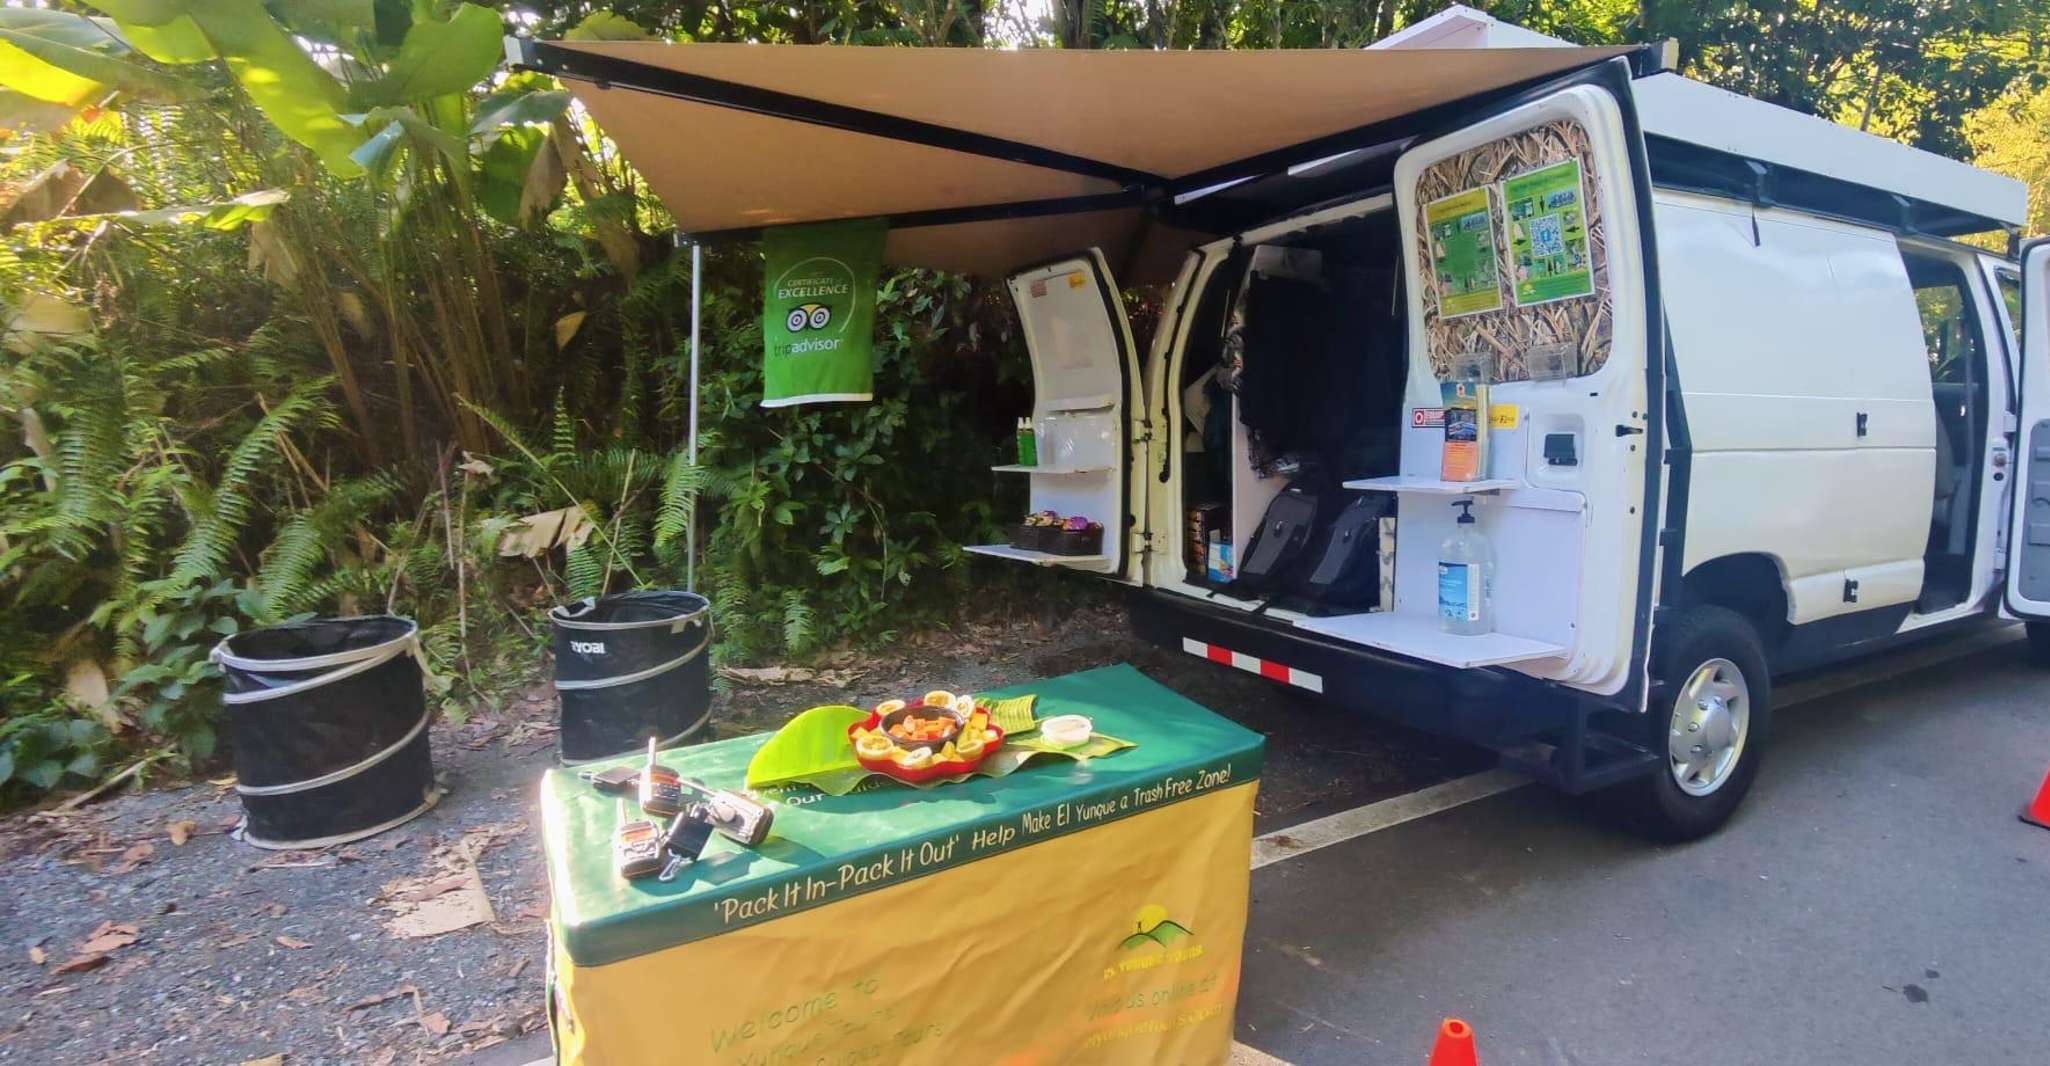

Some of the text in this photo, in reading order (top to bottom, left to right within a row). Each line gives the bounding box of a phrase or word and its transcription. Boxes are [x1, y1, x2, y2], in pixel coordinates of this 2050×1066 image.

[778, 284, 849, 299] EXCELLENCE
[773, 337, 841, 358] tripadvisor
[786, 793, 825, 806] Our
[784, 882, 799, 907] It
[805, 854, 895, 901] In-Pack
[901, 849, 913, 873] It
[971, 825, 1016, 850] Help
[1021, 811, 1051, 835] Make
[1056, 803, 1070, 827] El
[1076, 800, 1116, 822] Yunque
[1120, 795, 1128, 808] a
[1133, 783, 1163, 807] Trash
[1164, 777, 1192, 798] Free
[1195, 763, 1232, 789] Zone!
